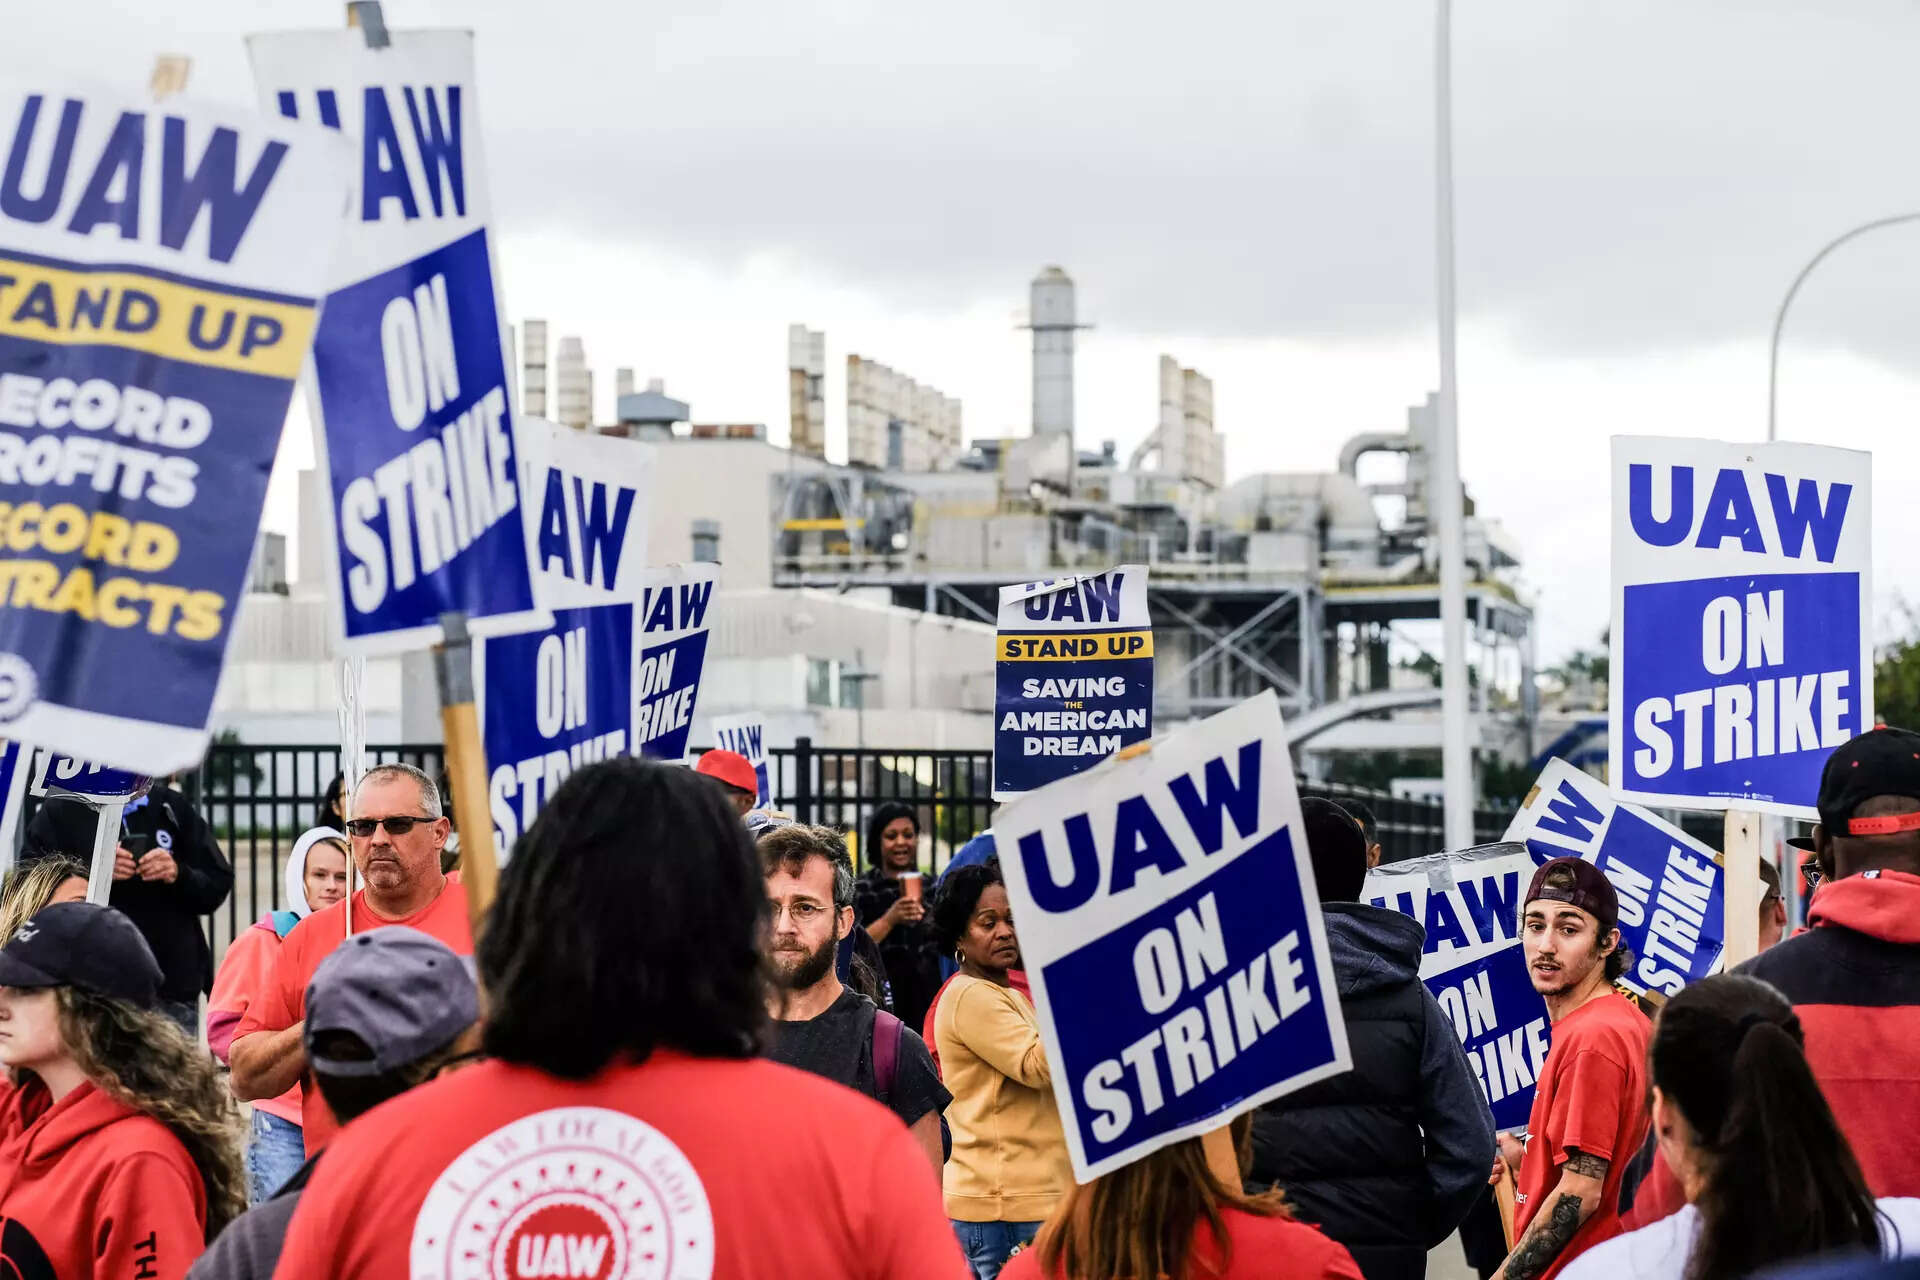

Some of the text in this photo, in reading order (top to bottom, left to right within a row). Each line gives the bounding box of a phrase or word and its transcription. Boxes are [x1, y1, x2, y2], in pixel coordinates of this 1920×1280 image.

[0, 95, 290, 263] UAW
[278, 86, 466, 221] AW
[187, 304, 283, 357] UP
[381, 273, 461, 431] ON
[0, 373, 213, 450] ECORD
[0, 501, 180, 572] CORD
[342, 385, 516, 614] STRIKE
[538, 467, 638, 591] AW
[1629, 463, 1853, 564] UAW
[643, 580, 713, 632] AW
[1005, 636, 1145, 658] STAND UP
[1702, 589, 1785, 675] ON
[536, 626, 588, 739] ON
[641, 648, 677, 700] ON
[1022, 676, 1126, 699] SAVING
[1064, 701, 1083, 709] THE
[1000, 708, 1147, 731] AMERICAN
[1023, 735, 1122, 756] DREAM
[1634, 669, 1850, 779] STRIKE
[1017, 738, 1263, 914] UAW
[1132, 891, 1229, 1015] ON
[1370, 871, 1519, 954] AW
[1637, 844, 1717, 998] STRIKE
[1082, 929, 1312, 1144] STRIKE
[1437, 970, 1498, 1044] ON
[516, 1233, 609, 1279] UAW
